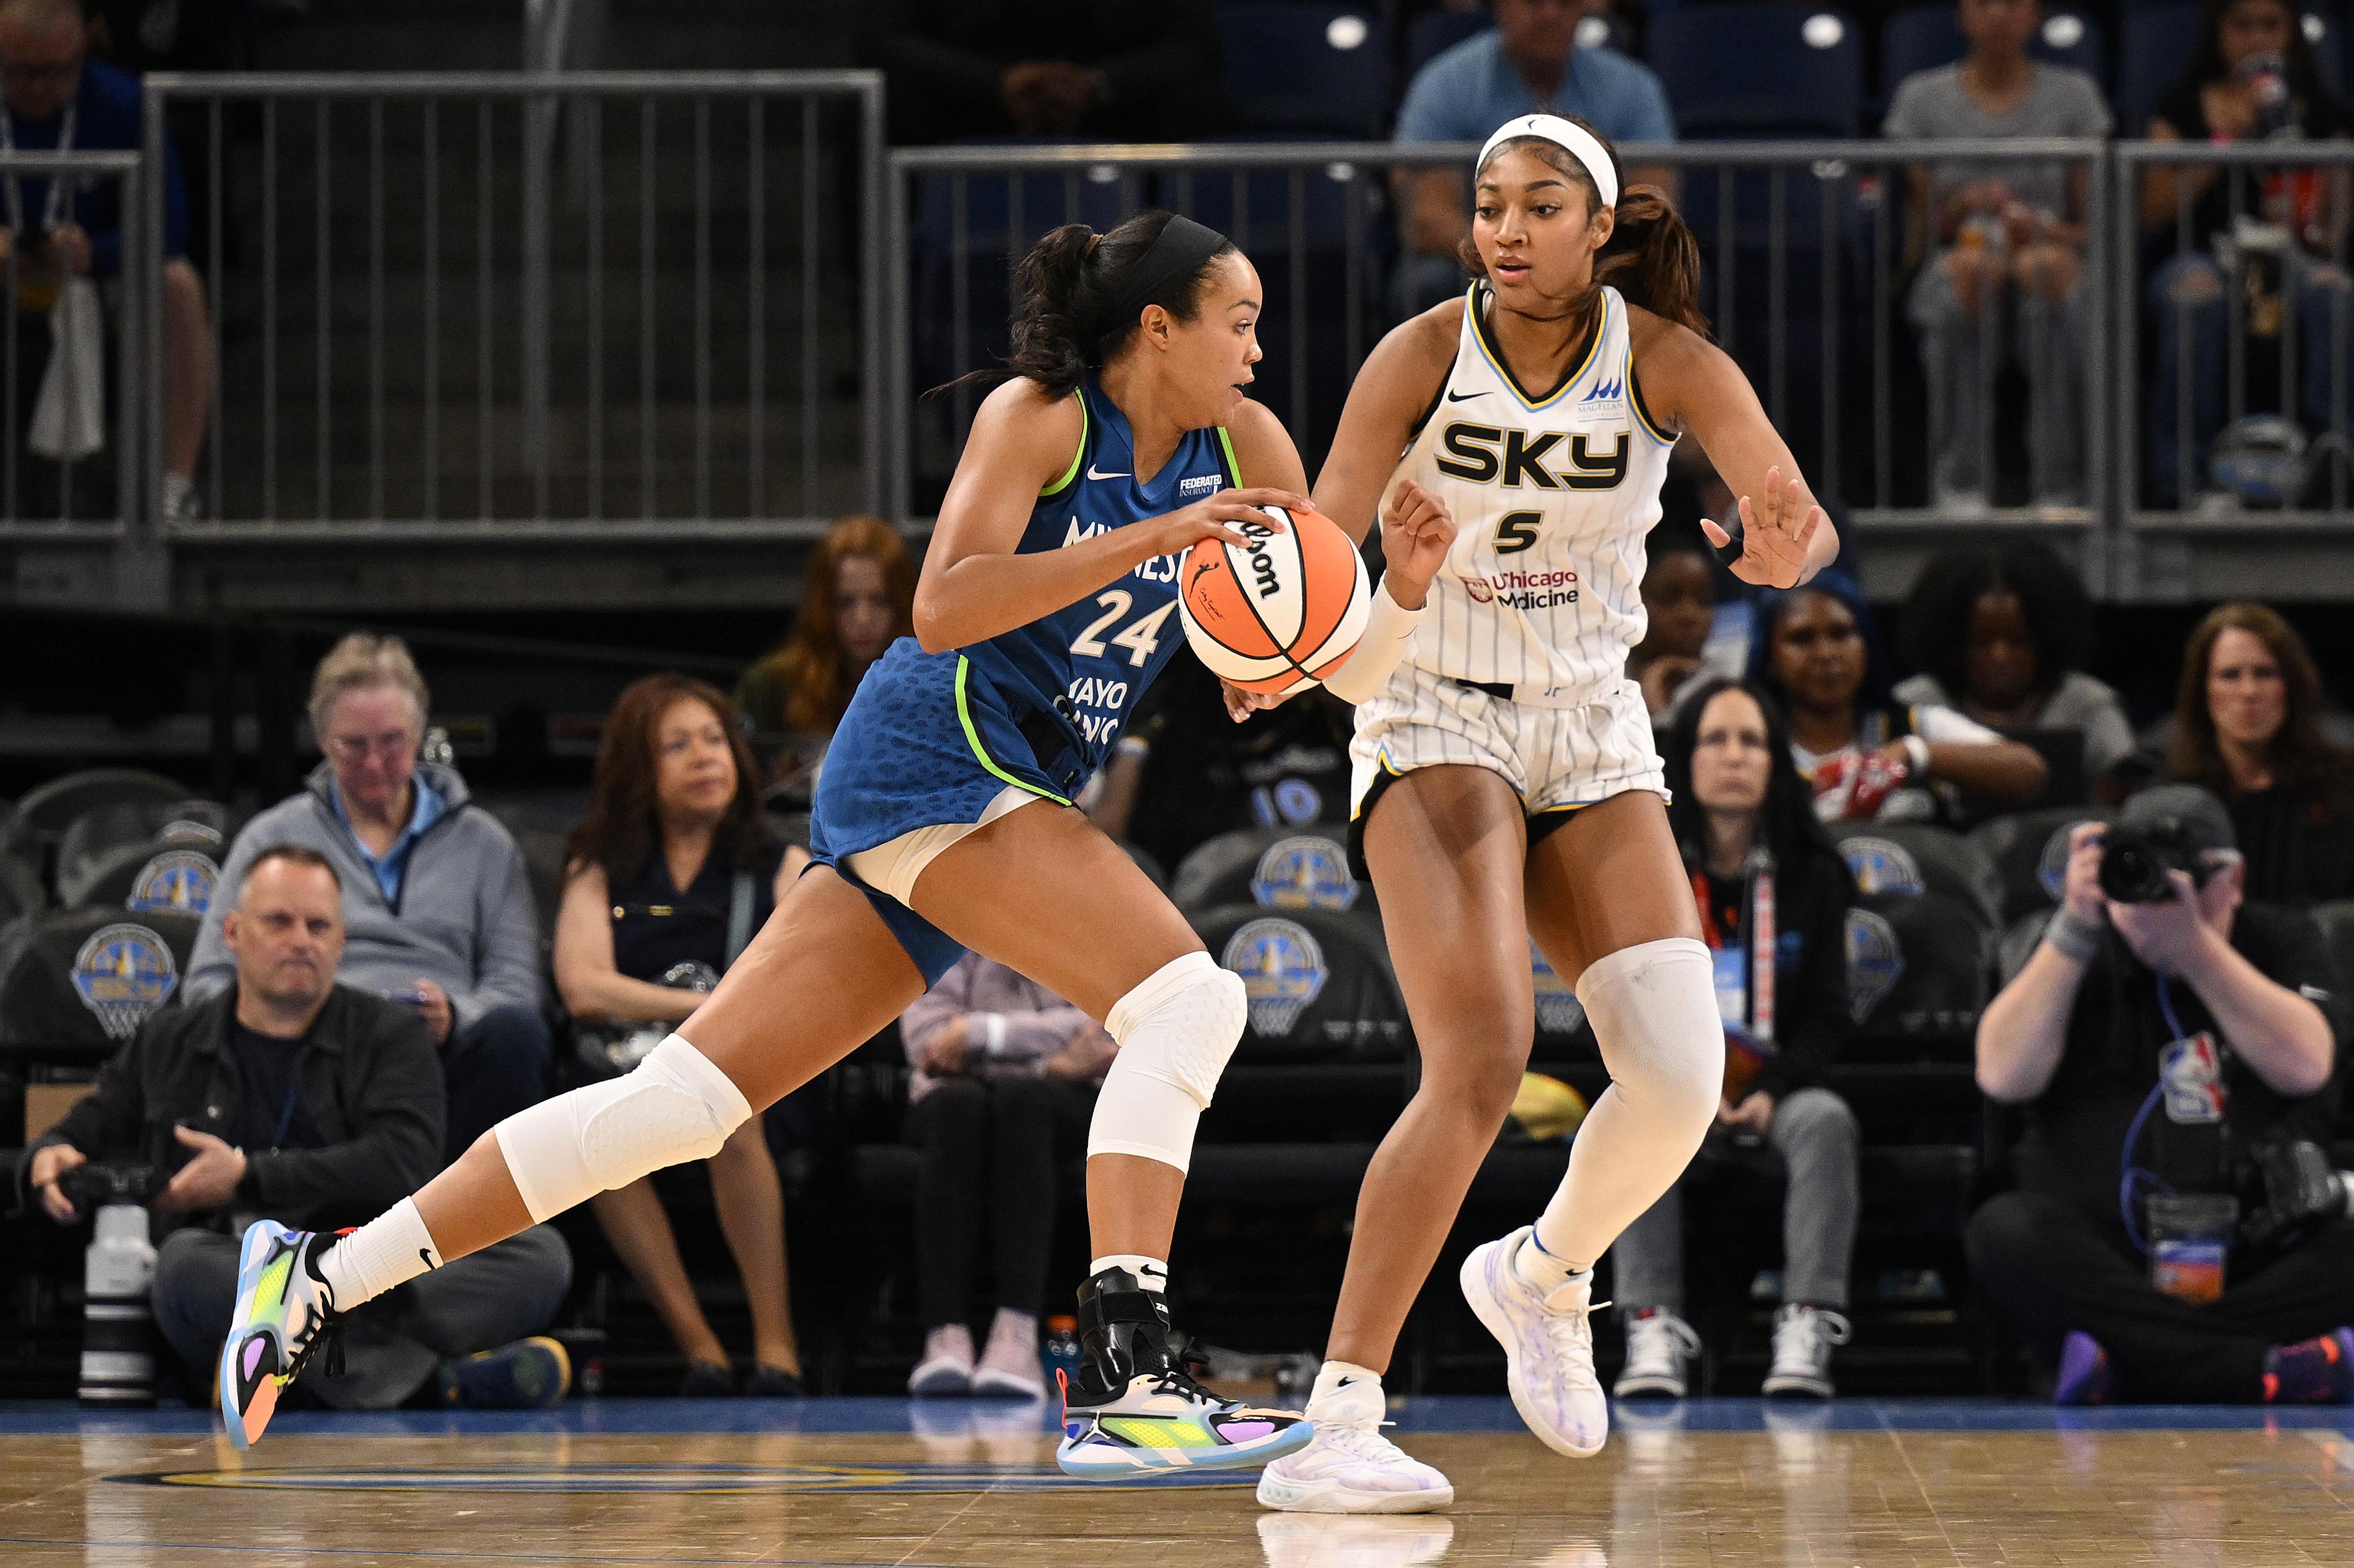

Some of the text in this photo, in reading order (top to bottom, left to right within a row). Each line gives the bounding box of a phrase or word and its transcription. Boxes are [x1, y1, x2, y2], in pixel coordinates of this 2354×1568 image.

[1433, 420, 1631, 492] SKY
[1179, 486, 1212, 497] INSURANCE
[1180, 474, 1222, 490] FEDERATED
[1492, 509, 1544, 555] 5
[1497, 589, 1579, 610] Mdicine
[1069, 589, 1178, 667] 24
